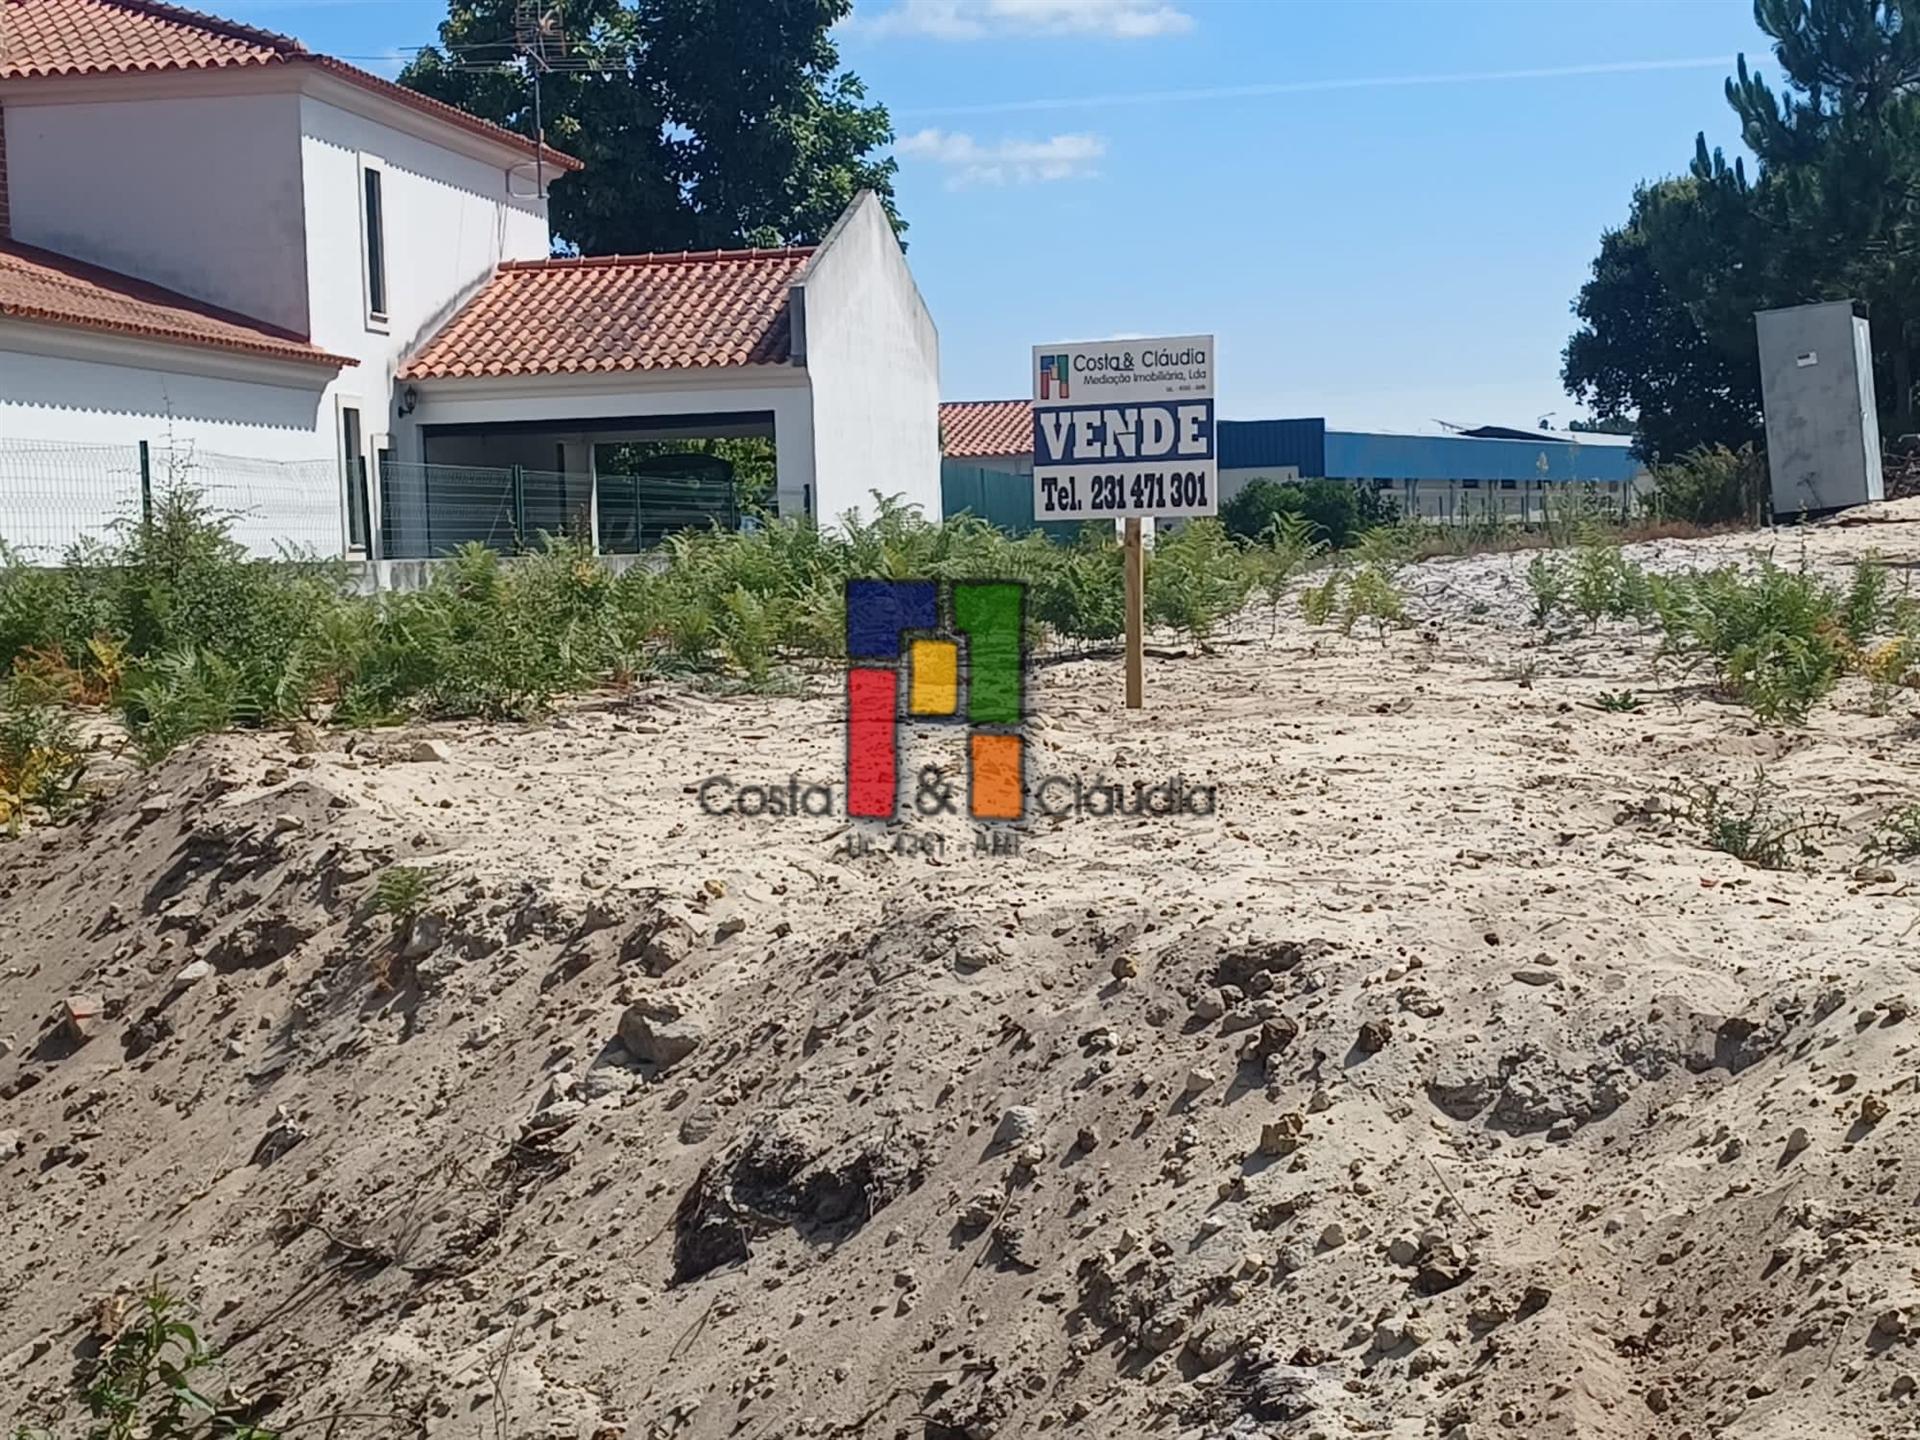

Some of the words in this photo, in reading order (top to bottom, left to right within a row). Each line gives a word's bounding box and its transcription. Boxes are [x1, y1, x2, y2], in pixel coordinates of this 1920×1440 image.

[1073, 353, 1120, 372] Costa
[1123, 352, 1134, 369] &
[1142, 348, 1205, 368] Cláudia
[1083, 374, 1131, 386] Mediação
[1040, 405, 1207, 460] VENDE
[1041, 476, 1082, 511] Tel.
[1091, 474, 1126, 509] 231
[1130, 472, 1166, 508] 471
[1170, 471, 1207, 508] 301
